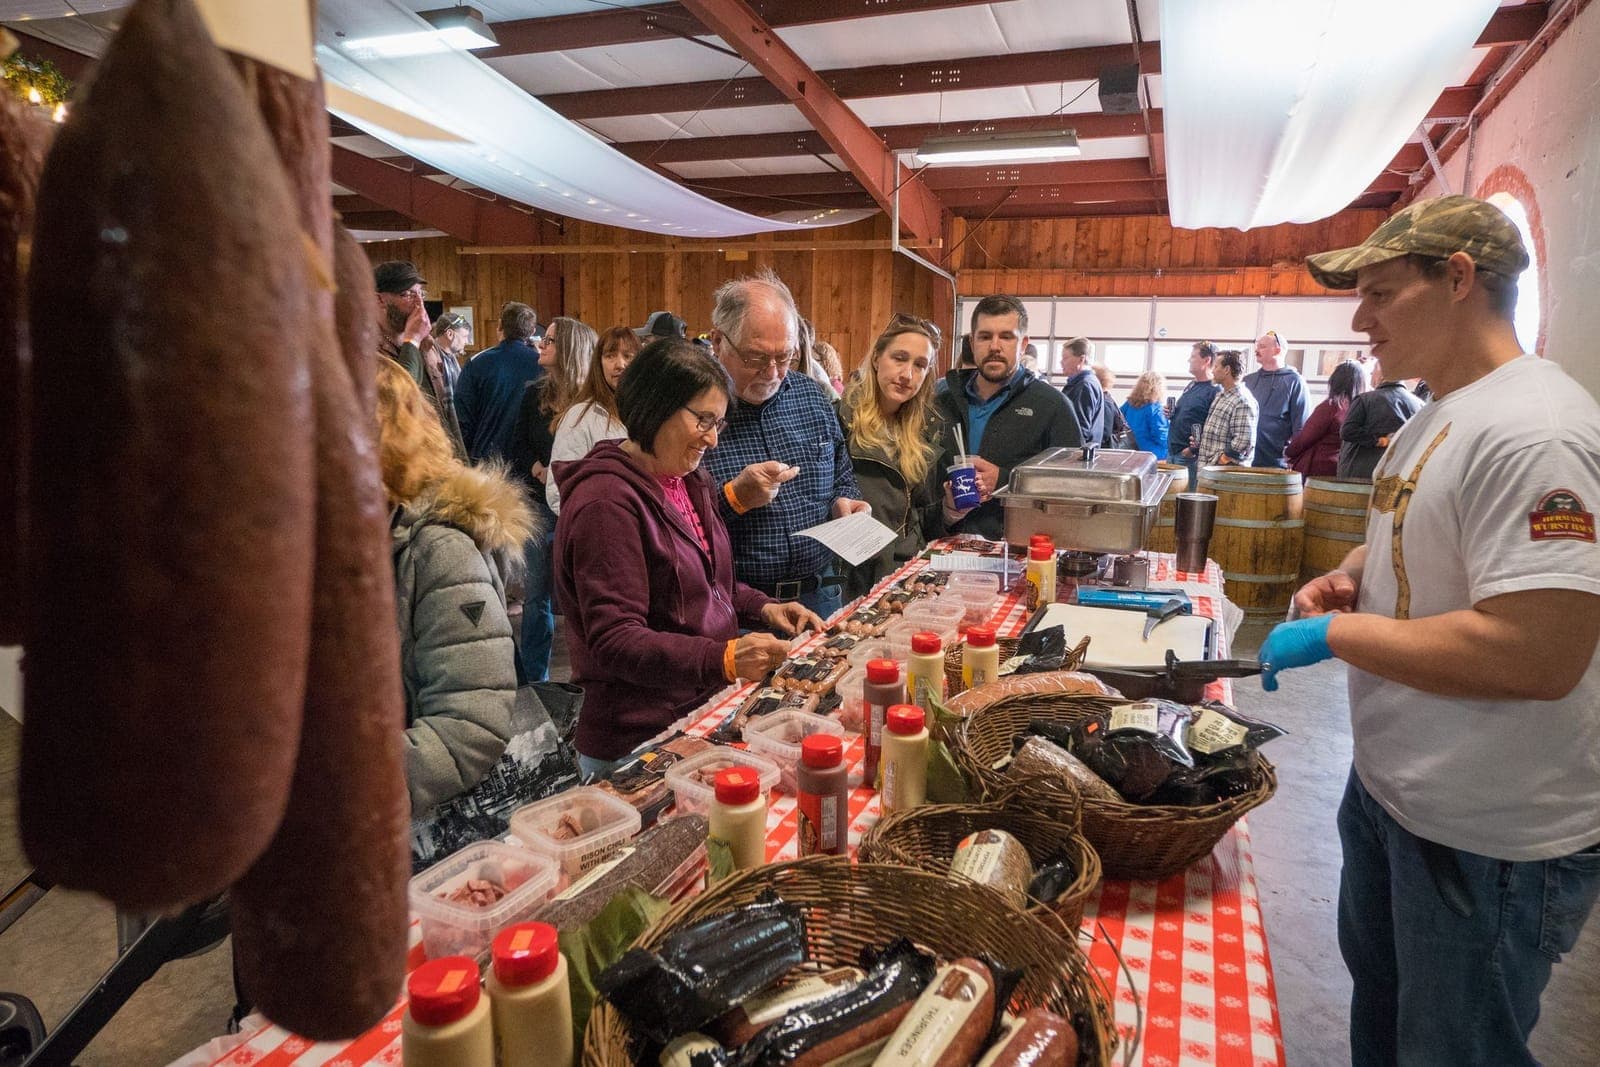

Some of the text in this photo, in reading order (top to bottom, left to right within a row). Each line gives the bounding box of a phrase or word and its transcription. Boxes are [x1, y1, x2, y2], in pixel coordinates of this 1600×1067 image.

[1533, 523, 1569, 531] WURST
[581, 847, 605, 861] BISON
[580, 857, 600, 870] WITH
